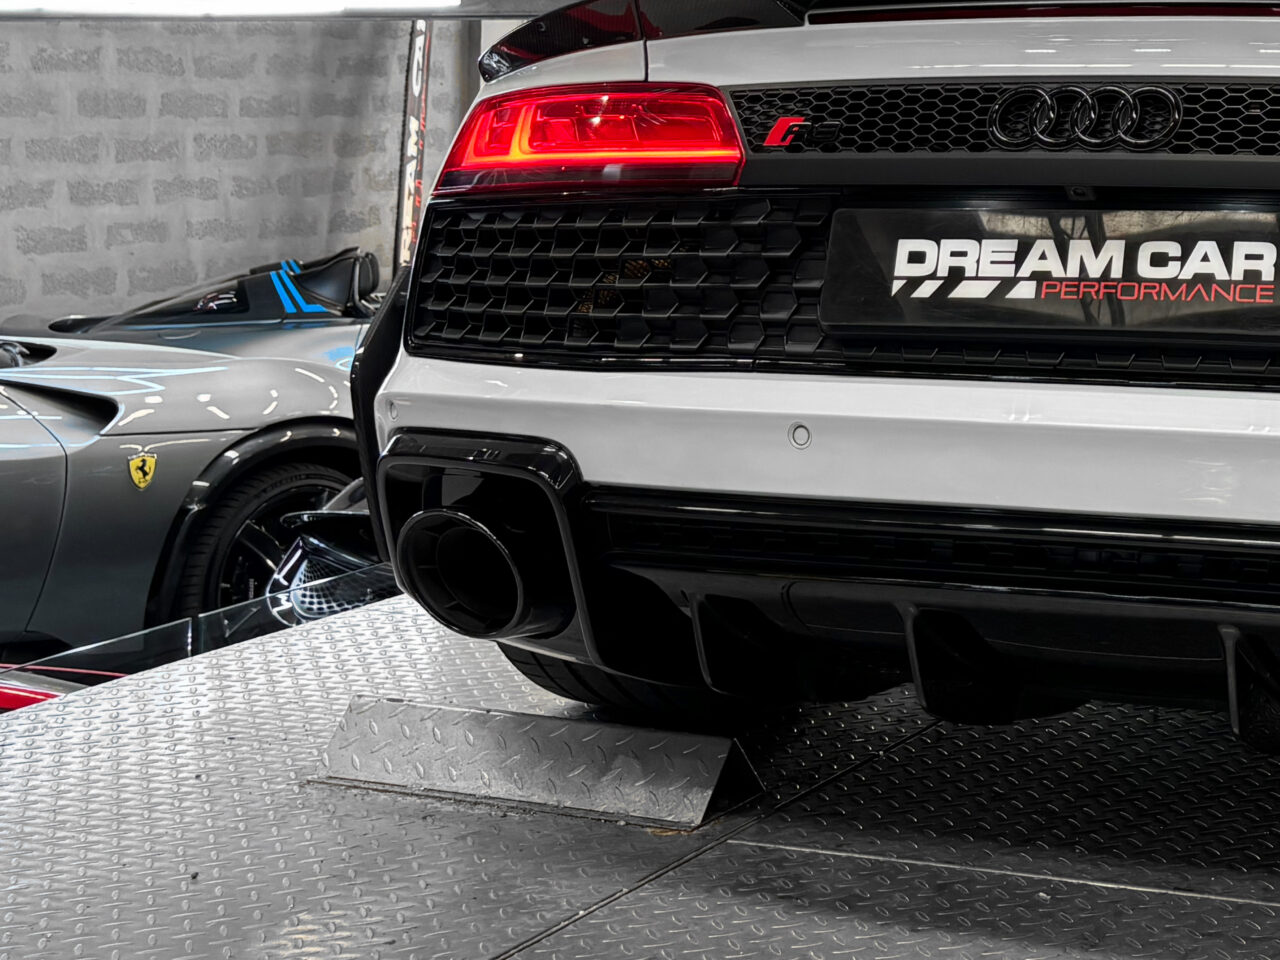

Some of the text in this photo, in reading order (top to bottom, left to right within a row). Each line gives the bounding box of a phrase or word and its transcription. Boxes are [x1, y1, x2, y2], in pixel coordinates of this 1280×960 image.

[400, 115, 419, 267] REAM
[894, 239, 1277, 281] DREAM CAR
[1041, 280, 1274, 303] PERFORMANCE
